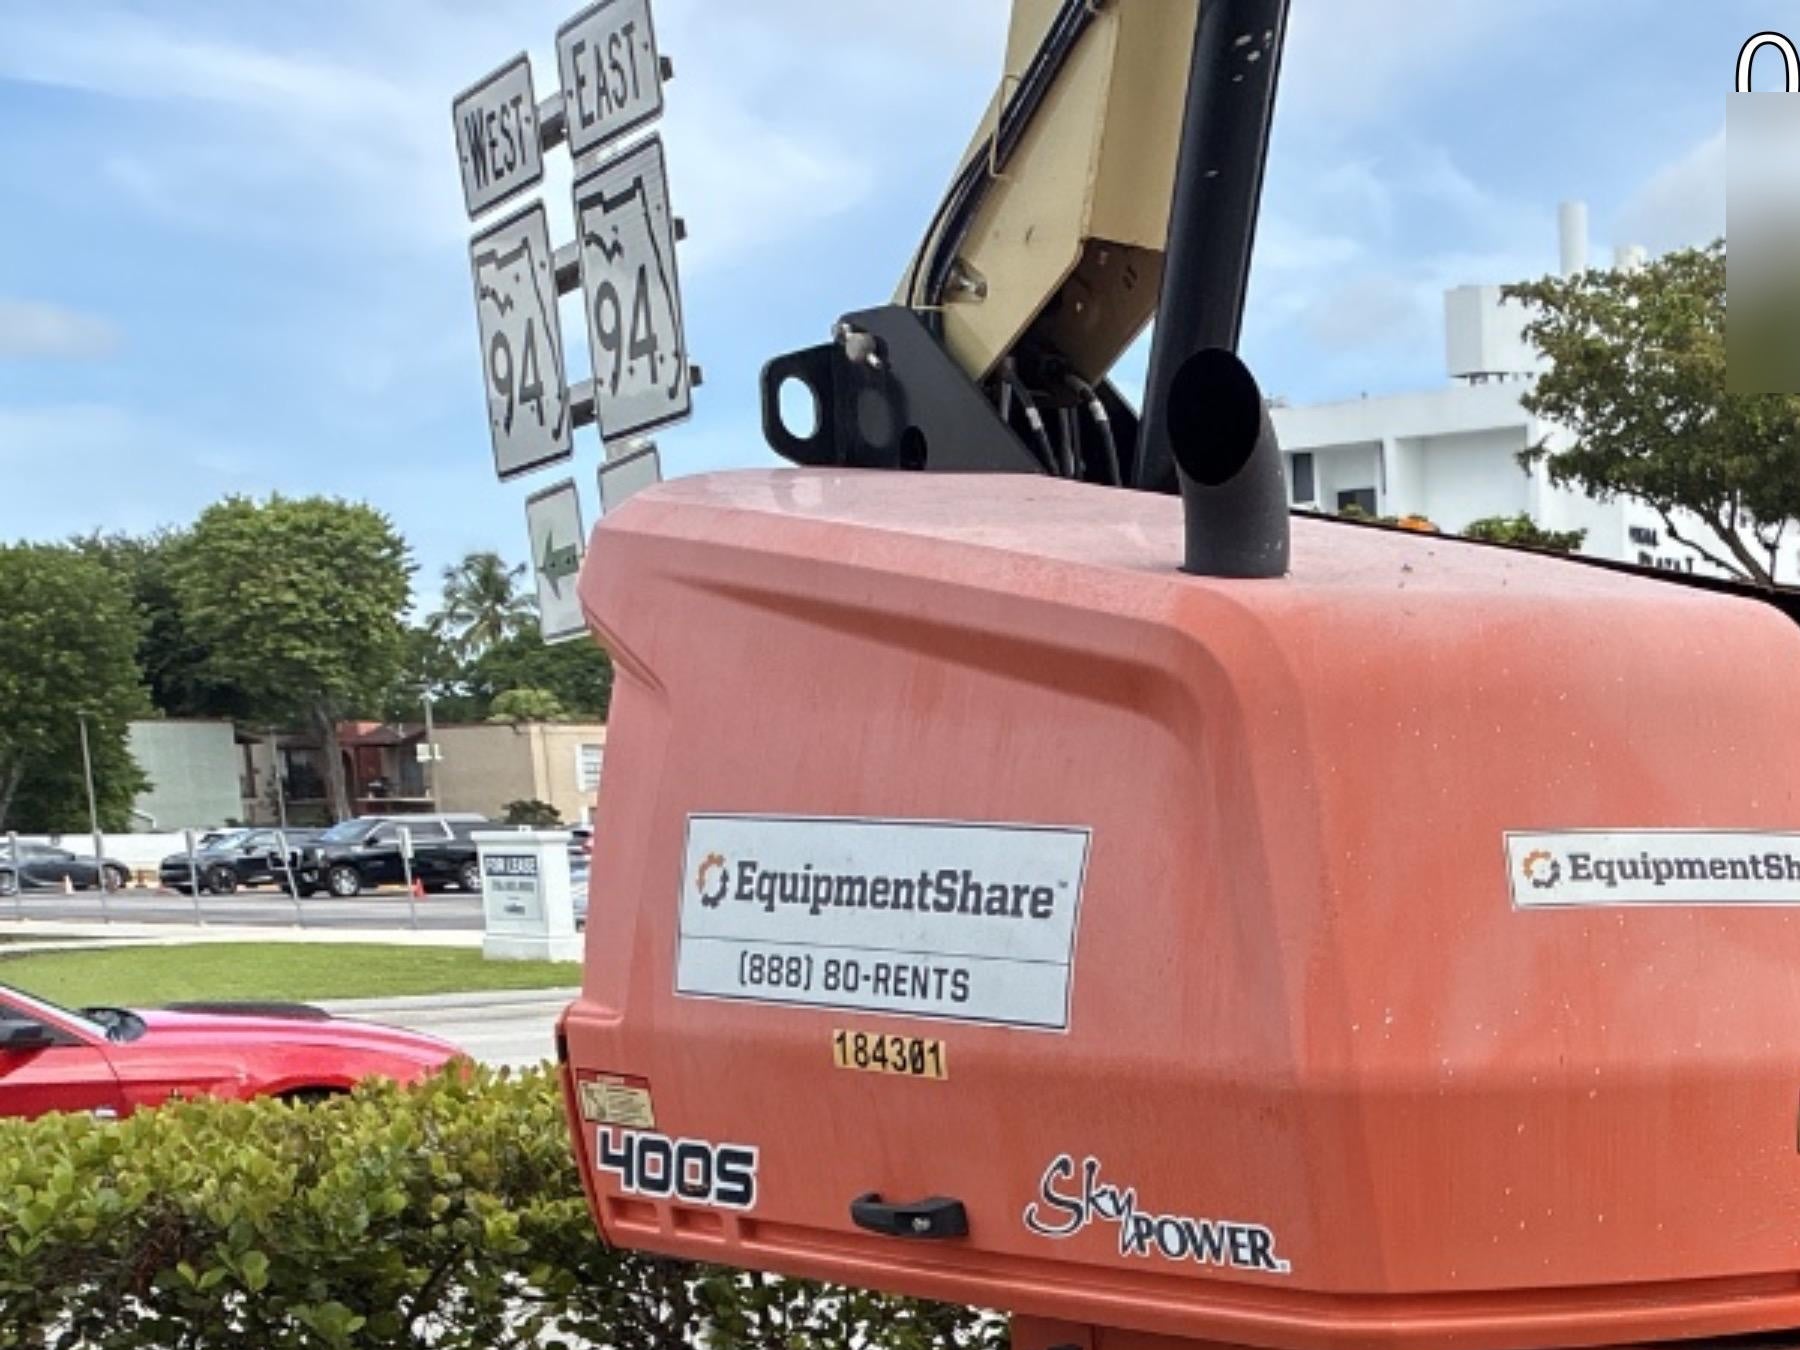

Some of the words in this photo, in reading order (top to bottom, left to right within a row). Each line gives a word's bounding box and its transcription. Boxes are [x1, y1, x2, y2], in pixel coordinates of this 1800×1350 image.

[572, 22, 639, 130] EAST
[465, 94, 529, 189] WEST
[488, 317, 545, 438] 94
[595, 263, 659, 398] 94
[733, 859, 1055, 920] EquipmentShare
[738, 950, 814, 991] (888)
[823, 959, 971, 1003] 80-RENTS
[834, 1031, 944, 1076] 184301
[599, 1129, 757, 1207] 400S
[1024, 1154, 1138, 1254] Sky
[1130, 1218, 1278, 1271] POWER
